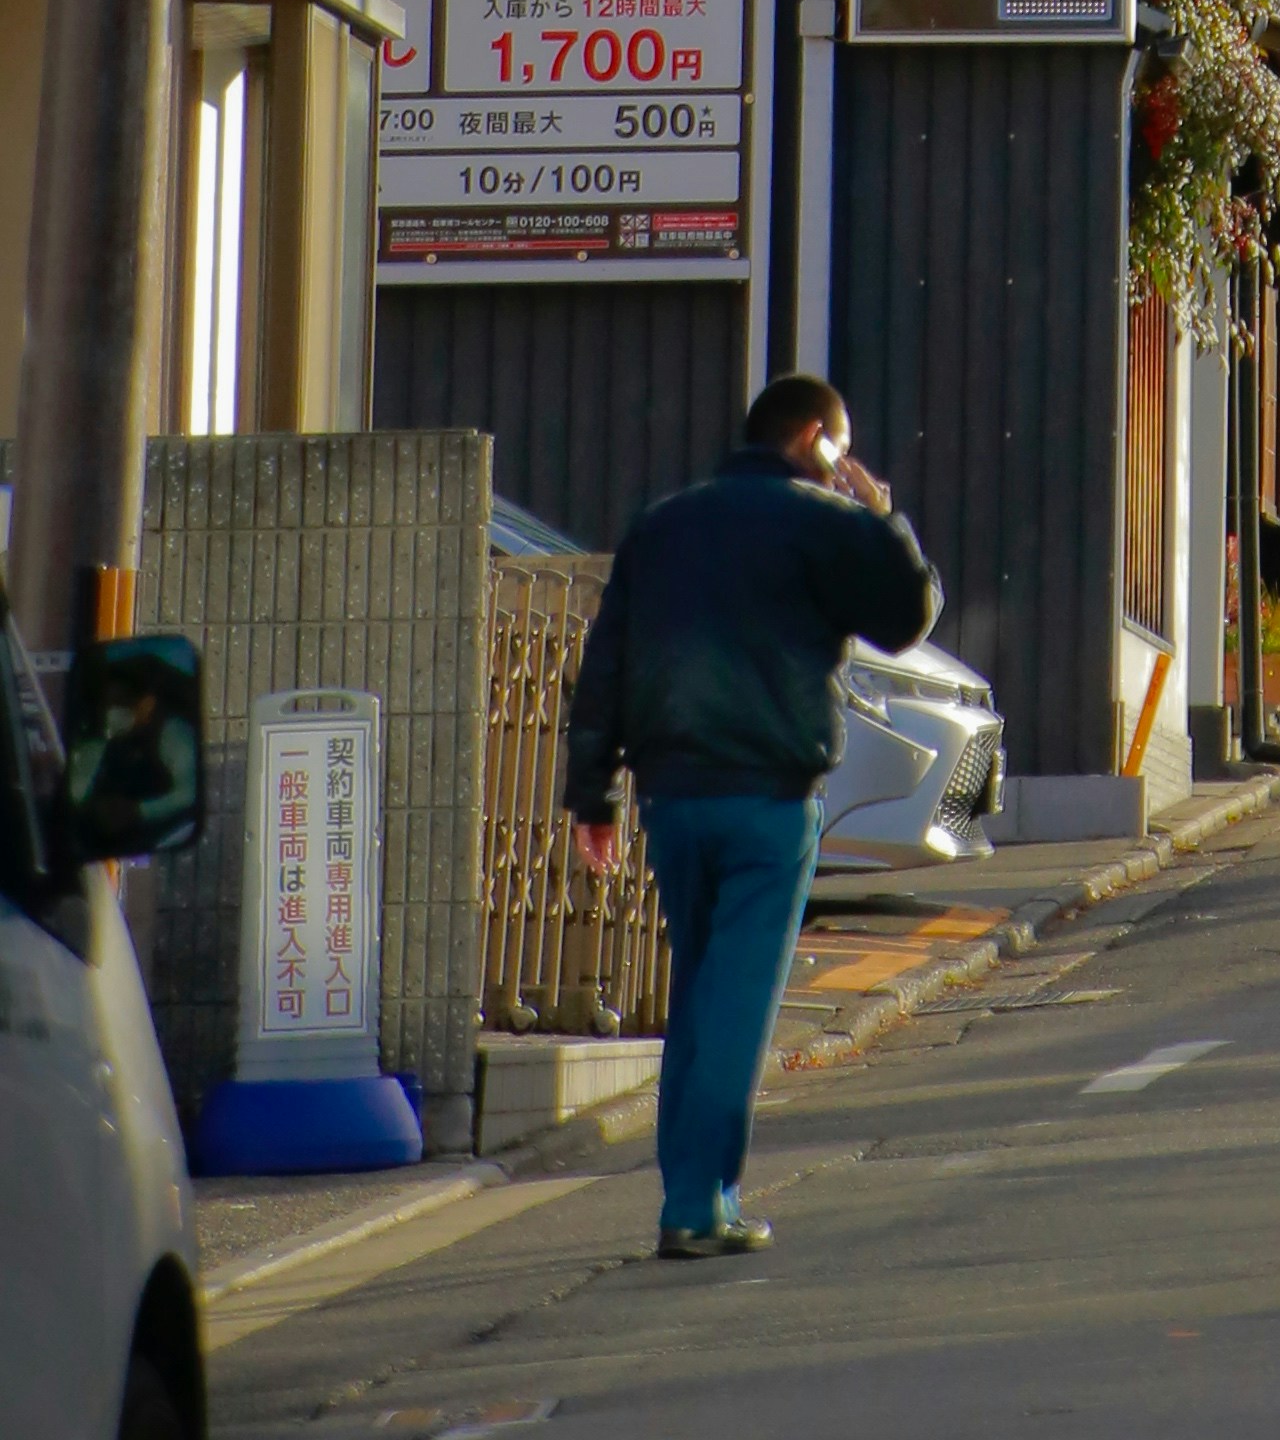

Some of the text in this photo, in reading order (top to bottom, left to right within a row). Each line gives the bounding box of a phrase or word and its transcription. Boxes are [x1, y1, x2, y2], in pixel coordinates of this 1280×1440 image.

[491, 30, 702, 84] 1,700円
[458, 111, 563, 136] 夜間最大
[460, 165, 641, 194] 10分/100円
[275, 746, 310, 1020] 一般車両は進入不可
[325, 737, 354, 1018] 契約車両専用進入口
